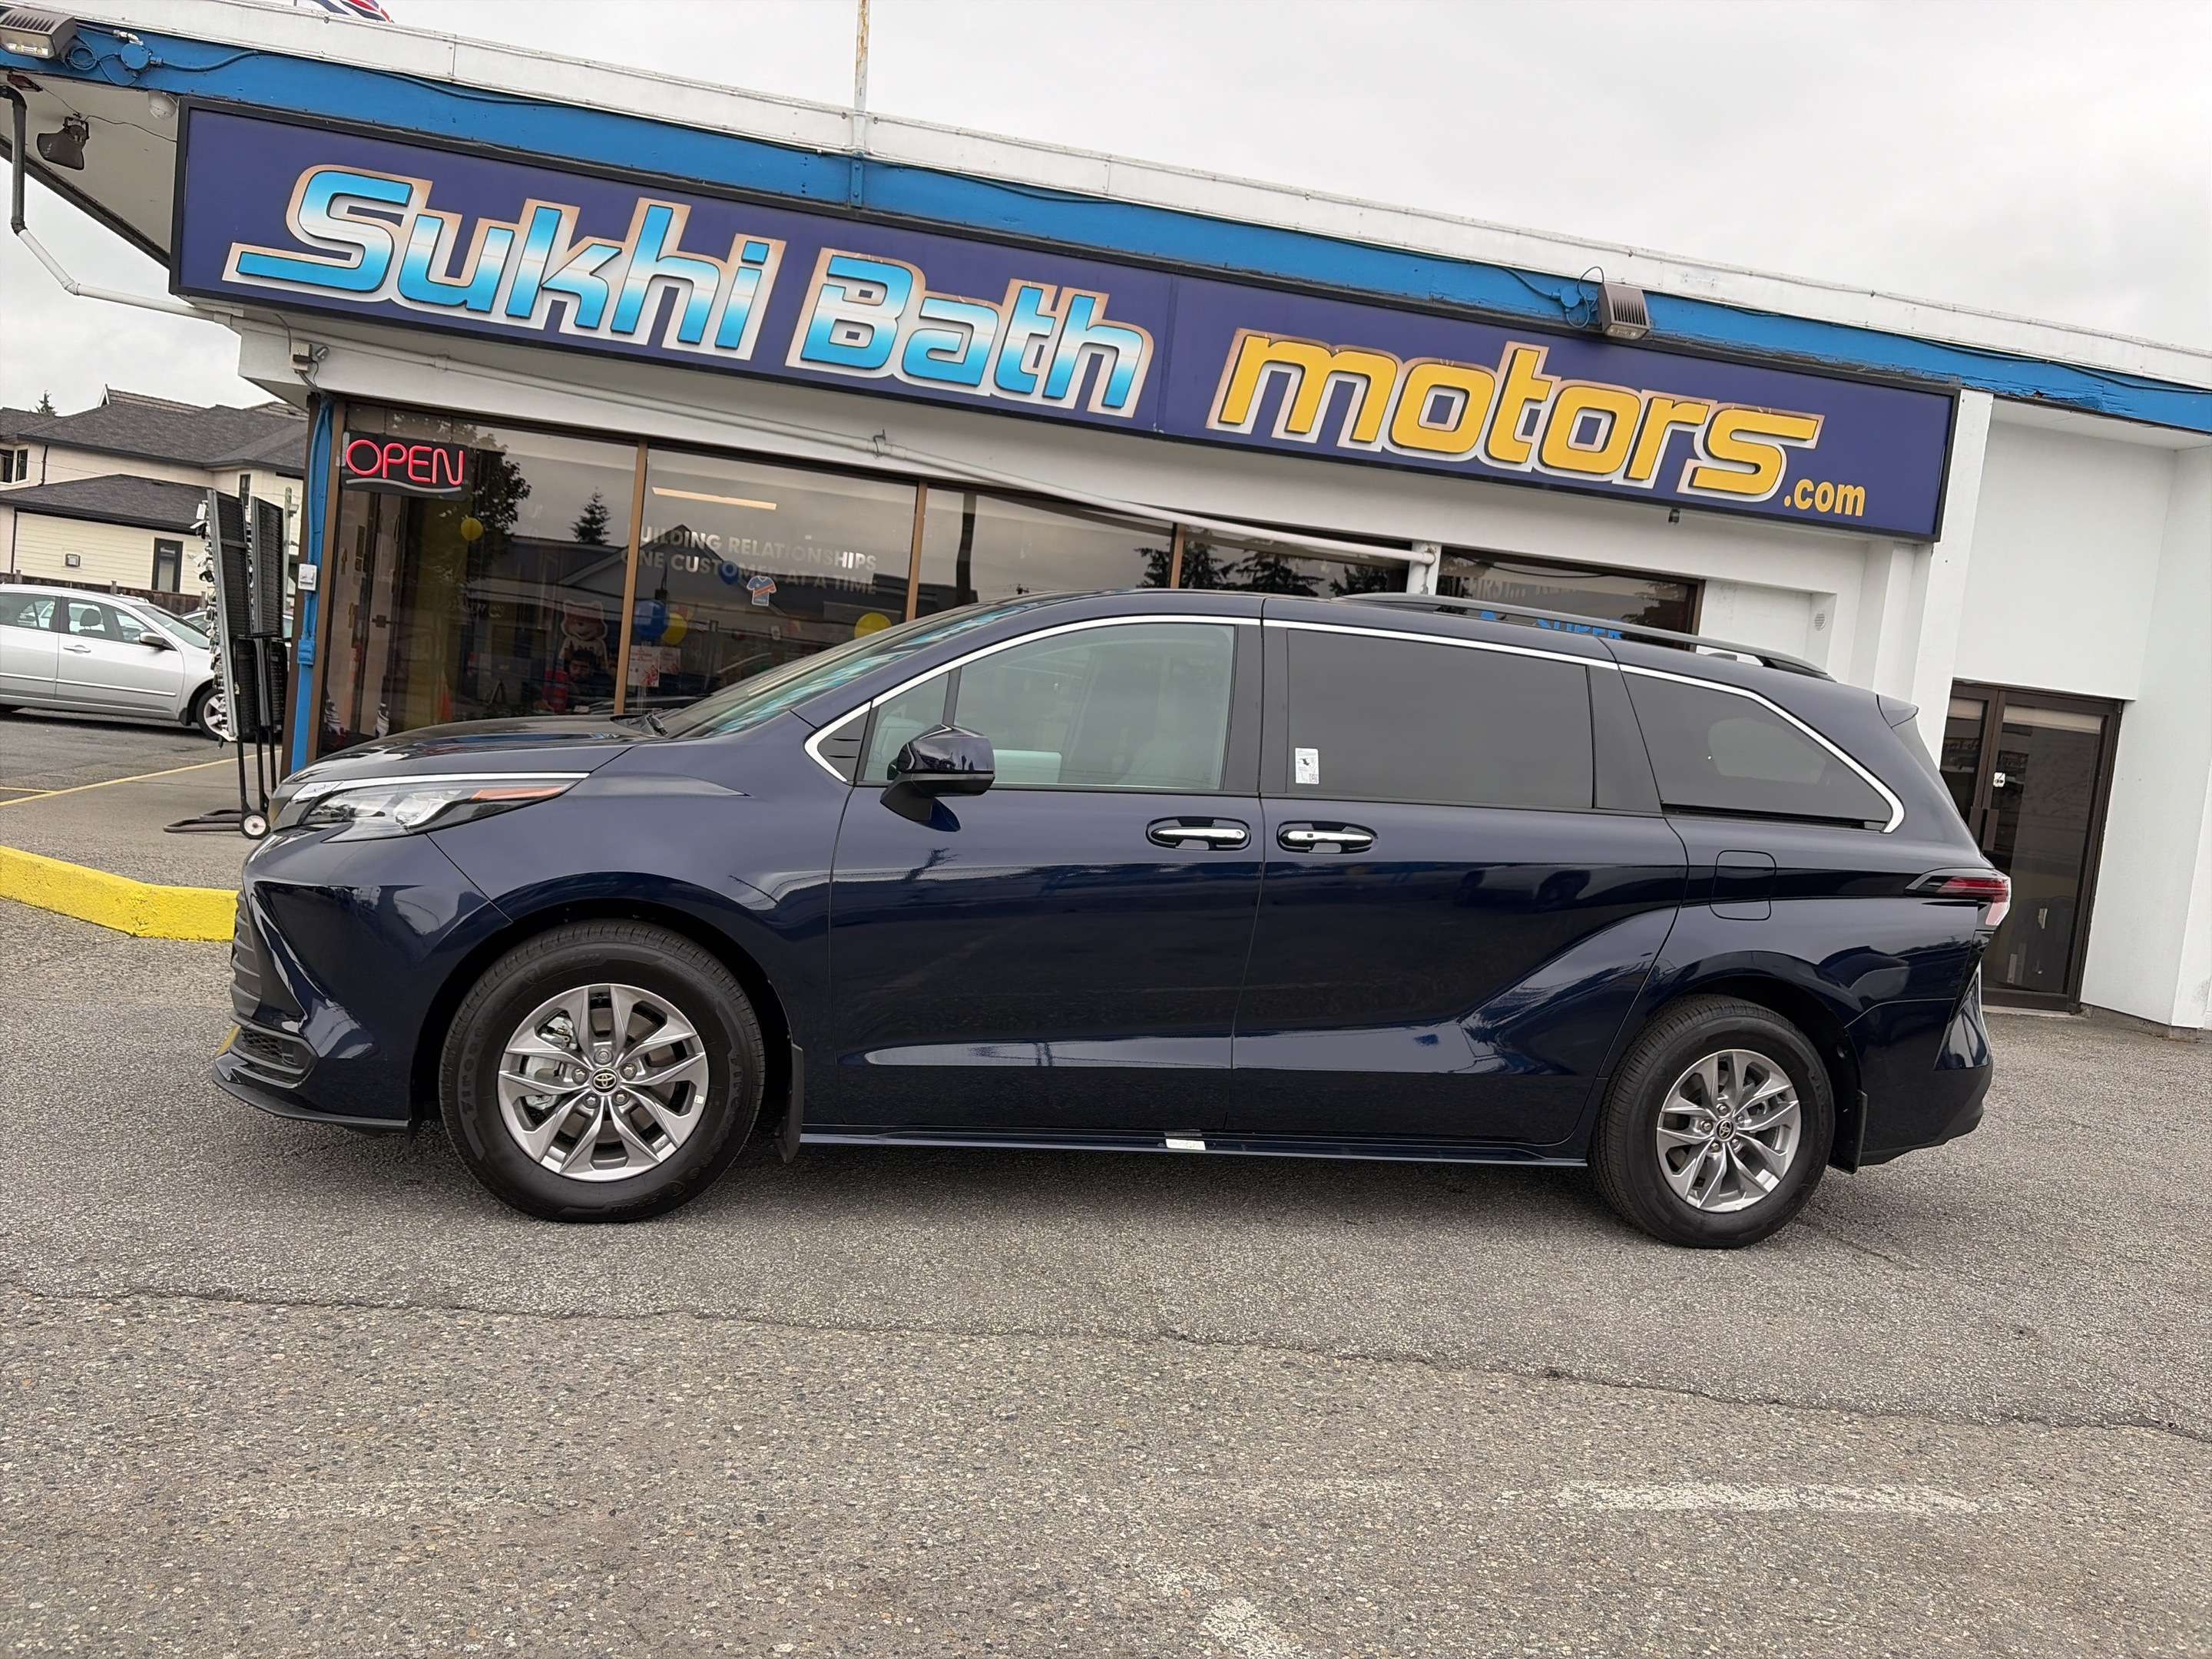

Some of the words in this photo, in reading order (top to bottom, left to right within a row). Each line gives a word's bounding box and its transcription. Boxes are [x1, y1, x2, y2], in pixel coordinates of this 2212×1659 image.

[223, 164, 786, 360] Sukhi
[786, 248, 1154, 418] Bath
[346, 439, 464, 486] OPEN
[631, 525, 722, 554] UILDING
[727, 535, 877, 571] RELATIONSHIPS
[834, 575, 877, 596] TIME
